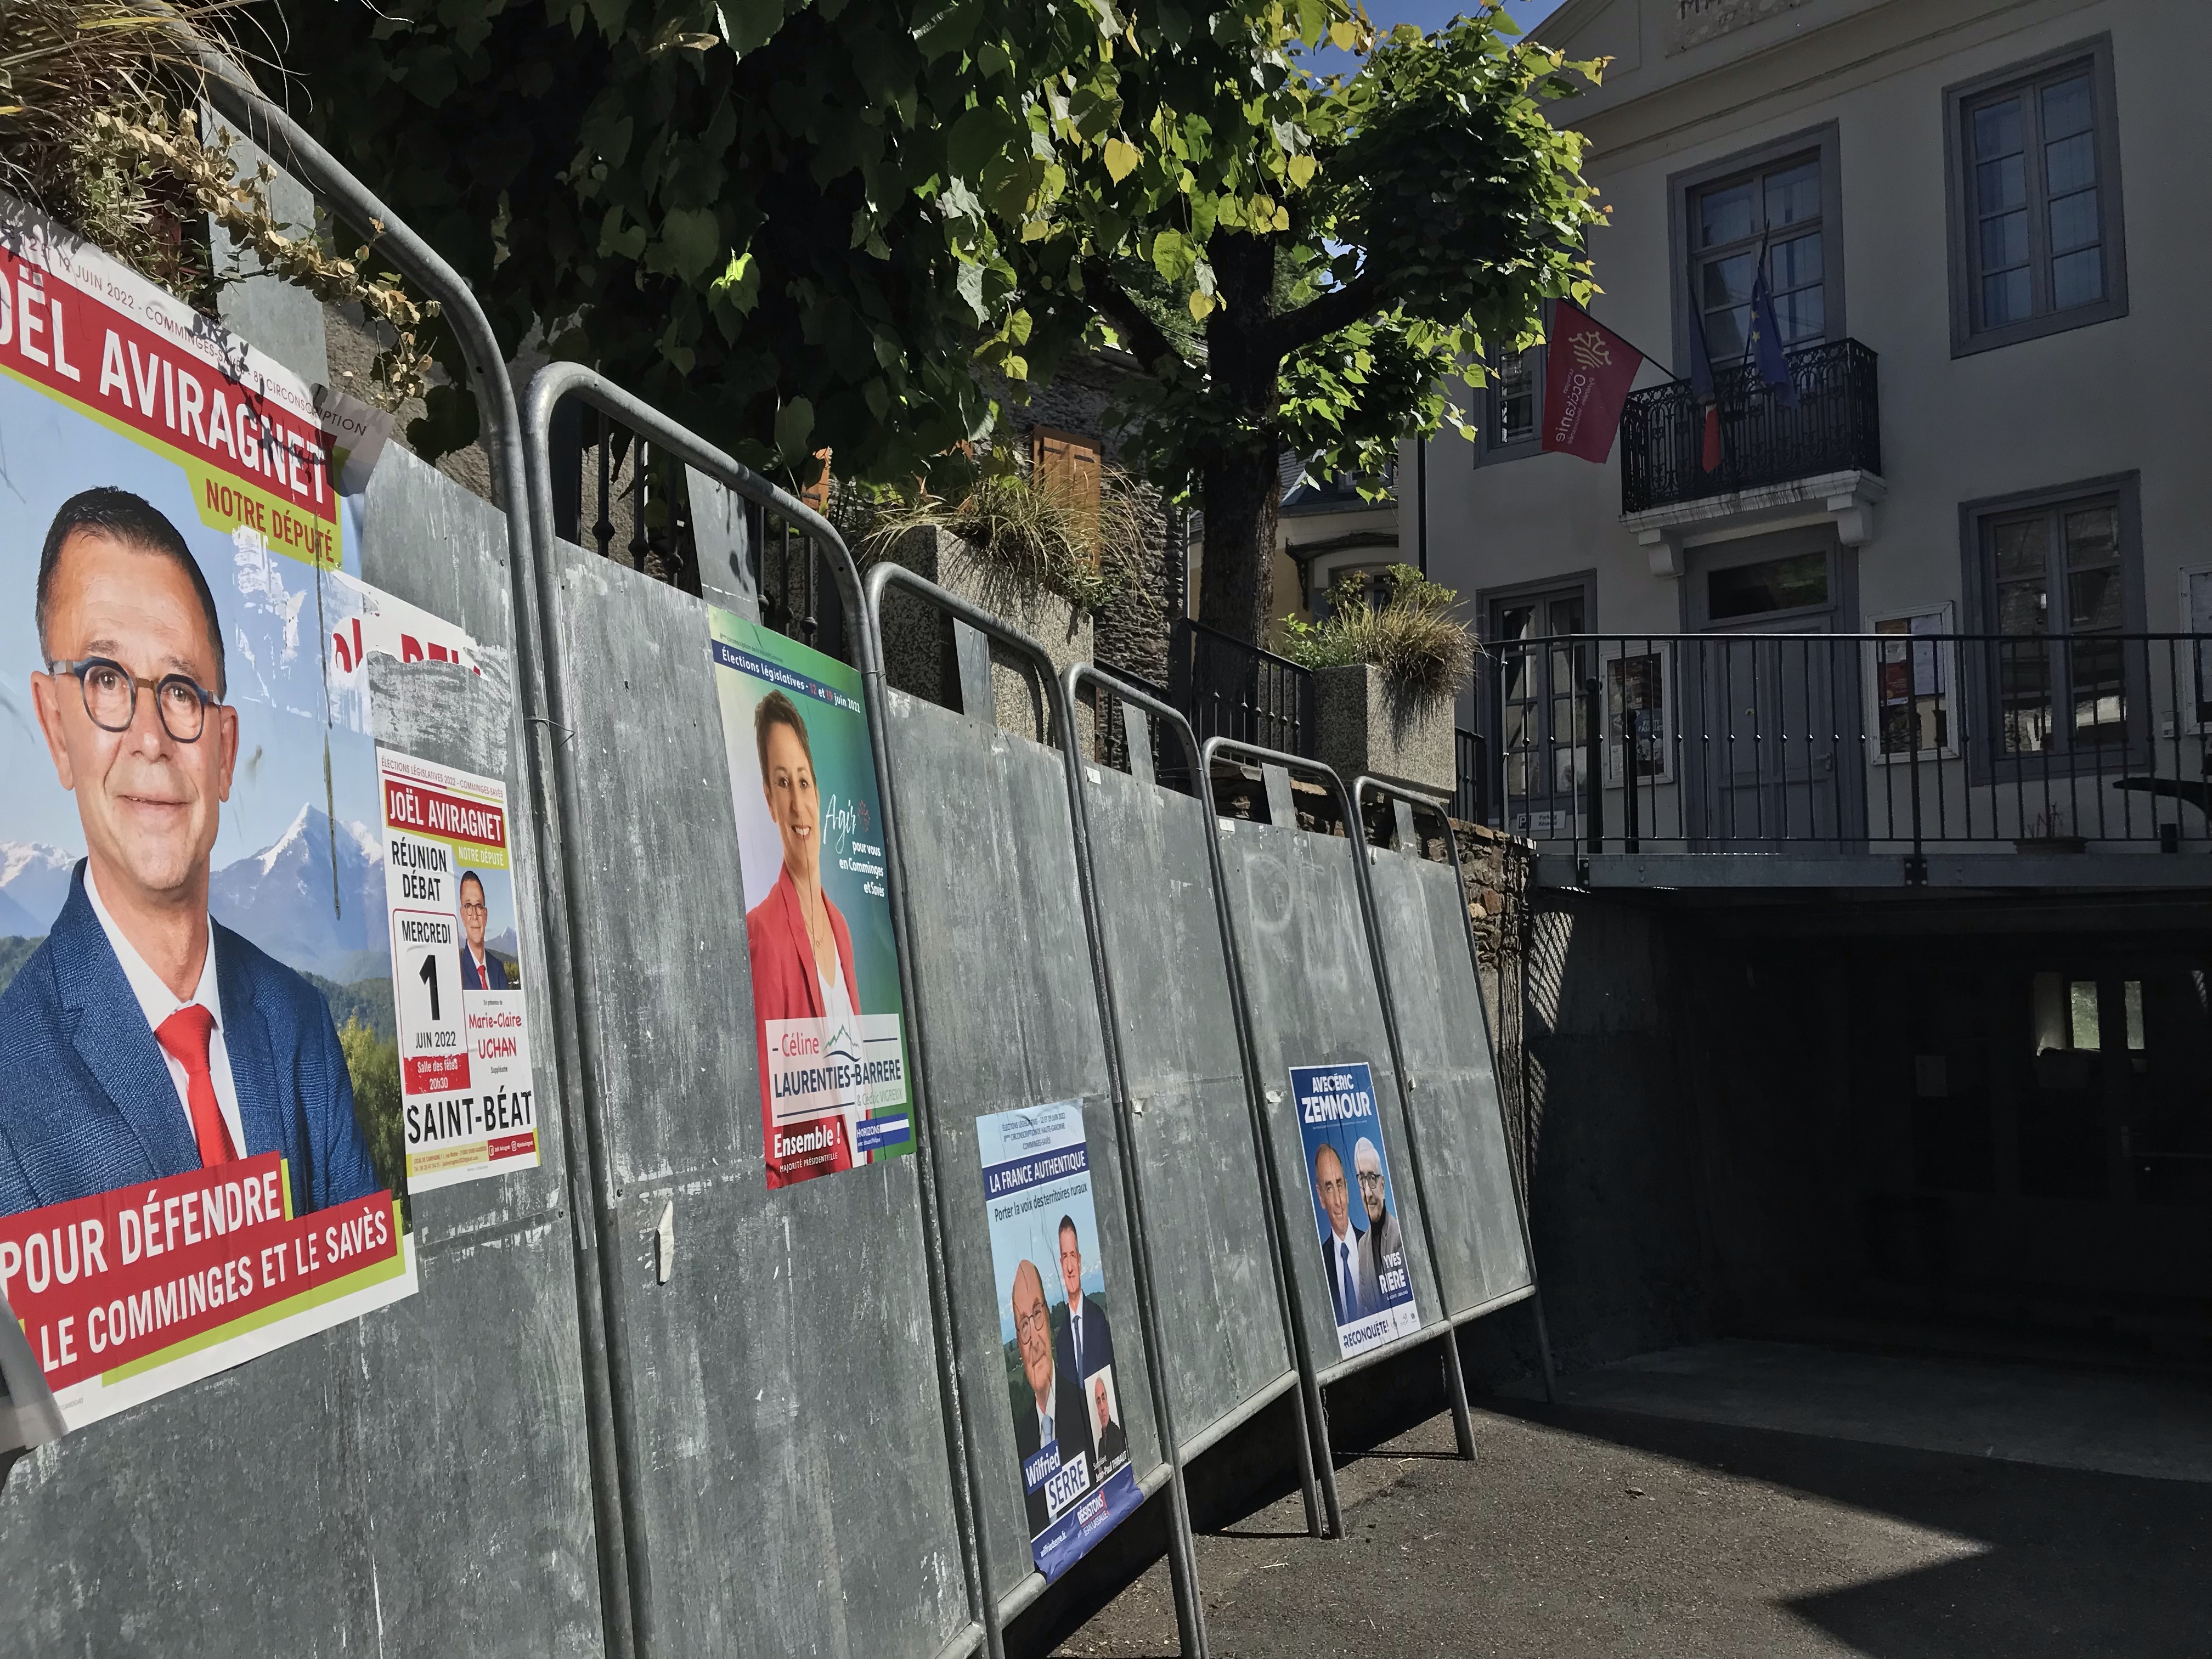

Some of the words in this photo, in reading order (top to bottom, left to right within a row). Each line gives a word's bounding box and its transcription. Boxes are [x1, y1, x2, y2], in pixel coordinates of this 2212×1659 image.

[76, 265, 103, 291] JUIN
[107, 283, 134, 309] 2022
[266, 379, 367, 436] CIRCONSCRIPTION
[99, 328, 326, 504] AVIRAGNET
[206, 478, 265, 532] NOTRE
[273, 510, 334, 563] DÉPUTÉ
[722, 646, 759, 673] Élections
[761, 665, 804, 690] législatives
[809, 682, 817, 695] 12
[818, 688, 826, 699] et
[834, 693, 847, 707] juin
[848, 698, 861, 713] 2022
[381, 755, 410, 773] ÉLECTIONS
[411, 765, 443, 782] LÉGISLATIVES
[444, 775, 456, 786] 2022
[390, 788, 424, 826] JOËL
[428, 799, 501, 842] AVIRAGNET
[823, 794, 856, 854] Agir
[391, 837, 447, 872] RÉUNION
[459, 846, 478, 861] NOTRE
[481, 849, 504, 866] DÉPUTÉ
[852, 840, 866, 855] pour
[866, 845, 881, 857] vous
[839, 858, 848, 870] en
[849, 858, 884, 879] Comminges
[402, 870, 441, 901] DÉBAT
[864, 881, 871, 894] et
[871, 881, 884, 897] Savès
[402, 920, 451, 944] MERCREDI
[419, 955, 440, 1020] 1
[469, 1012, 522, 1029] Marie-Claire
[416, 1032, 432, 1048] JUIN
[435, 1031, 456, 1047] 2022
[478, 1036, 517, 1059] UCHAN
[781, 1032, 819, 1057] Céline
[417, 1061, 431, 1074] Salle
[432, 1060, 443, 1071] des
[444, 1059, 458, 1071] fêtes
[774, 1059, 901, 1098] LAURENTIES-BARRERE
[429, 1077, 448, 1090] 20h30
[857, 1094, 861, 1107] &
[862, 1091, 879, 1105] Cédric
[879, 1088, 903, 1103] VIGREUX
[1312, 1075, 1335, 1093] AVEC
[1334, 1073, 1354, 1091] ÉRIC
[407, 1085, 532, 1144] SAINT-BÉAT
[1301, 1092, 1372, 1124] ZEMMOUR
[774, 1125, 834, 1159] Ensemble
[837, 1121, 841, 1144] !
[856, 1125, 881, 1138] HORIZONS
[1002, 1121, 1019, 1131] ÉLECTIONS
[1011, 1129, 1037, 1141] CIRCONSCRIPTION
[1041, 1122, 1065, 1133] HAUTE-GARONNE
[780, 1159, 803, 1173] MAJORITÉ
[803, 1152, 838, 1167] PRÉSIDENTIELLE
[989, 1173, 1001, 1193] LA
[1001, 1165, 1033, 1189] FRANCE
[1034, 1150, 1086, 1181] AUTHENTIQUE
[995, 1206, 1013, 1222] Porter
[1014, 1201, 1020, 1215] la
[1020, 1198, 1032, 1213] voix
[1034, 1195, 1043, 1209] des
[1043, 1188, 1070, 1206] territoires
[1071, 1183, 1088, 1197] ruraux
[0, 1219, 109, 1300] POUR
[119, 1171, 281, 1266] DÉFENDRE
[1383, 1251, 1402, 1269] YVES
[41, 1317, 77, 1373] LE
[88, 1256, 253, 1353] COMMINGES
[261, 1242, 288, 1288] ET
[295, 1233, 320, 1276] LE
[326, 1206, 388, 1263] SAVÈS
[1379, 1268, 1407, 1294] RIERE
[1343, 1319, 1390, 1349] RECONQUÊTE!
[62, 1397, 84, 1410] CANDIDAT
[1026, 1446, 1061, 1487] Wilfried
[1048, 1459, 1086, 1510] SERRE
[1077, 1494, 1104, 1525] RÉSISTONS
[1083, 1522, 1094, 1536] JEAN
